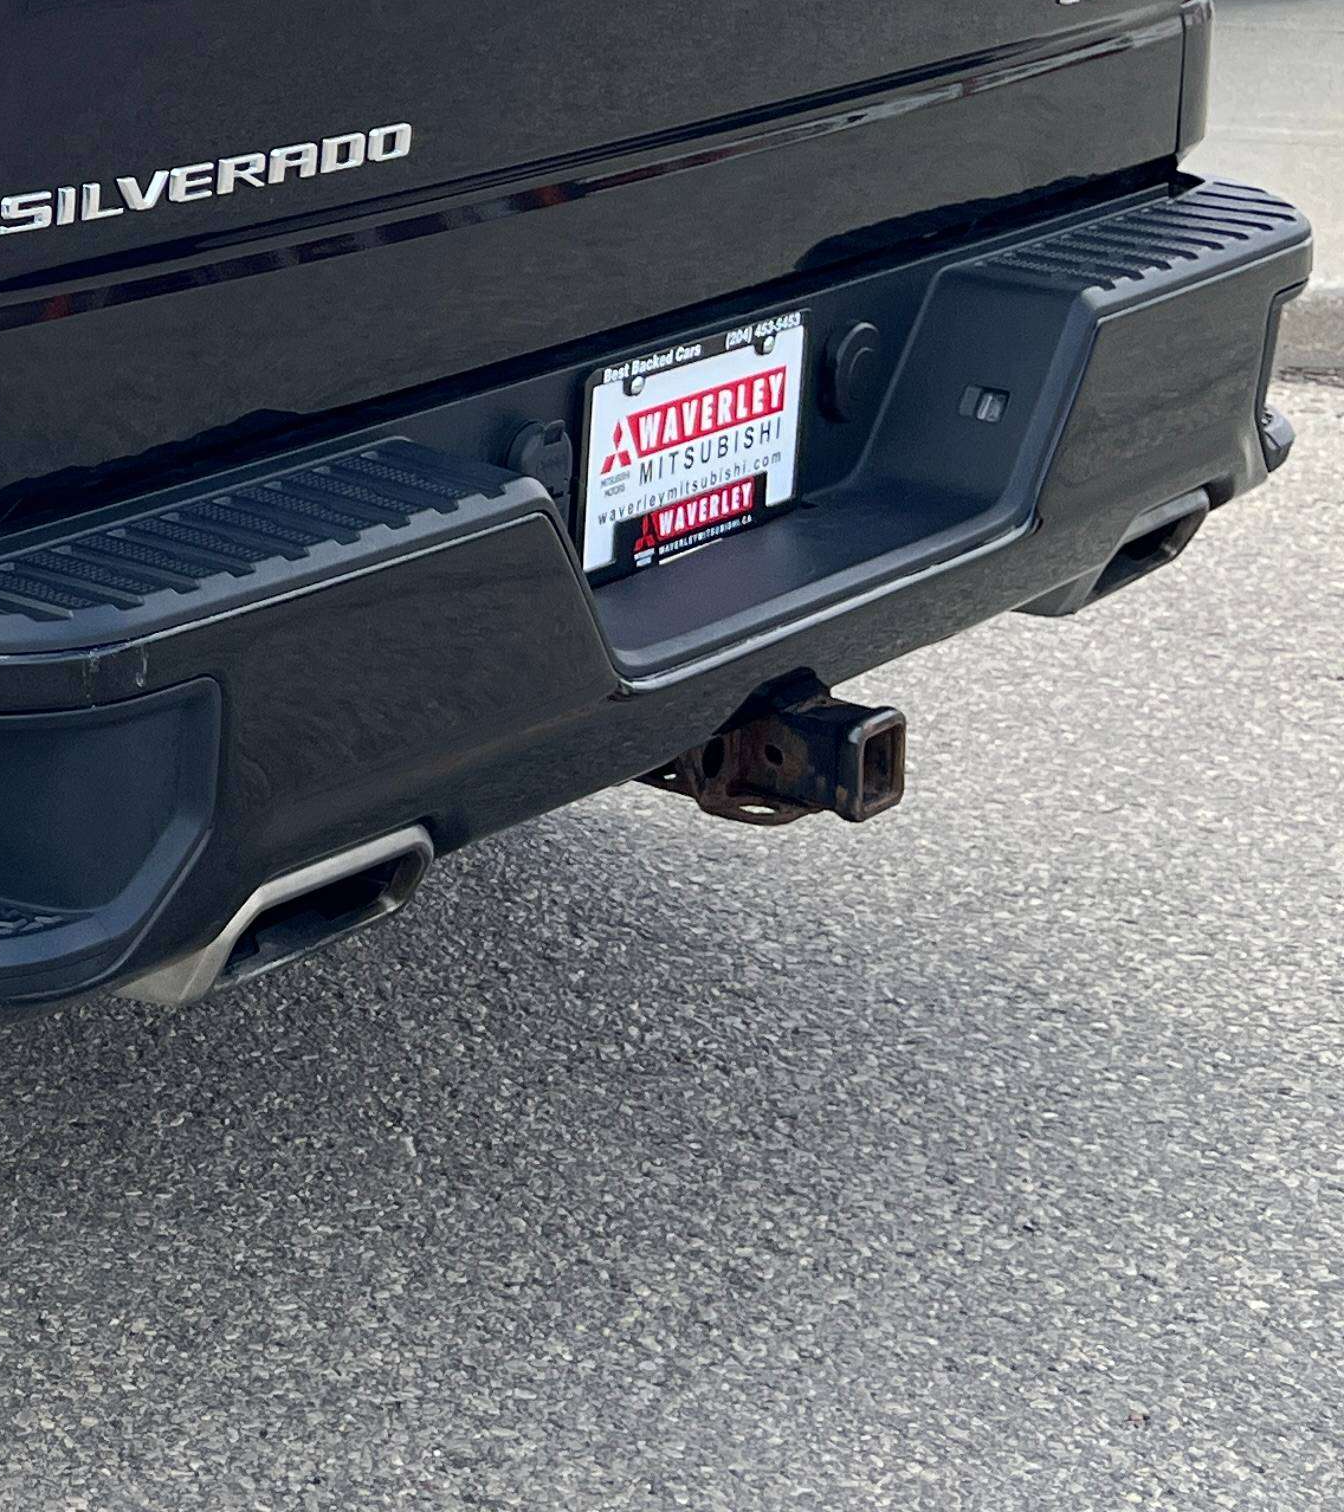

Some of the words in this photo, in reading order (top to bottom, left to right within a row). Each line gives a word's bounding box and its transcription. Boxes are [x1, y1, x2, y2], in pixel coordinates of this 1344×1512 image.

[0, 122, 411, 235] SILVERADO
[603, 363, 630, 384] Best
[631, 349, 673, 375] Backed
[675, 344, 702, 362] Cars
[725, 326, 752, 350] (204)
[638, 373, 784, 451] WAVERLEY
[639, 417, 782, 486] MITSUBISHI
[598, 451, 782, 525] waverleymitsubishi.com
[658, 482, 752, 537] WAVERLEY
